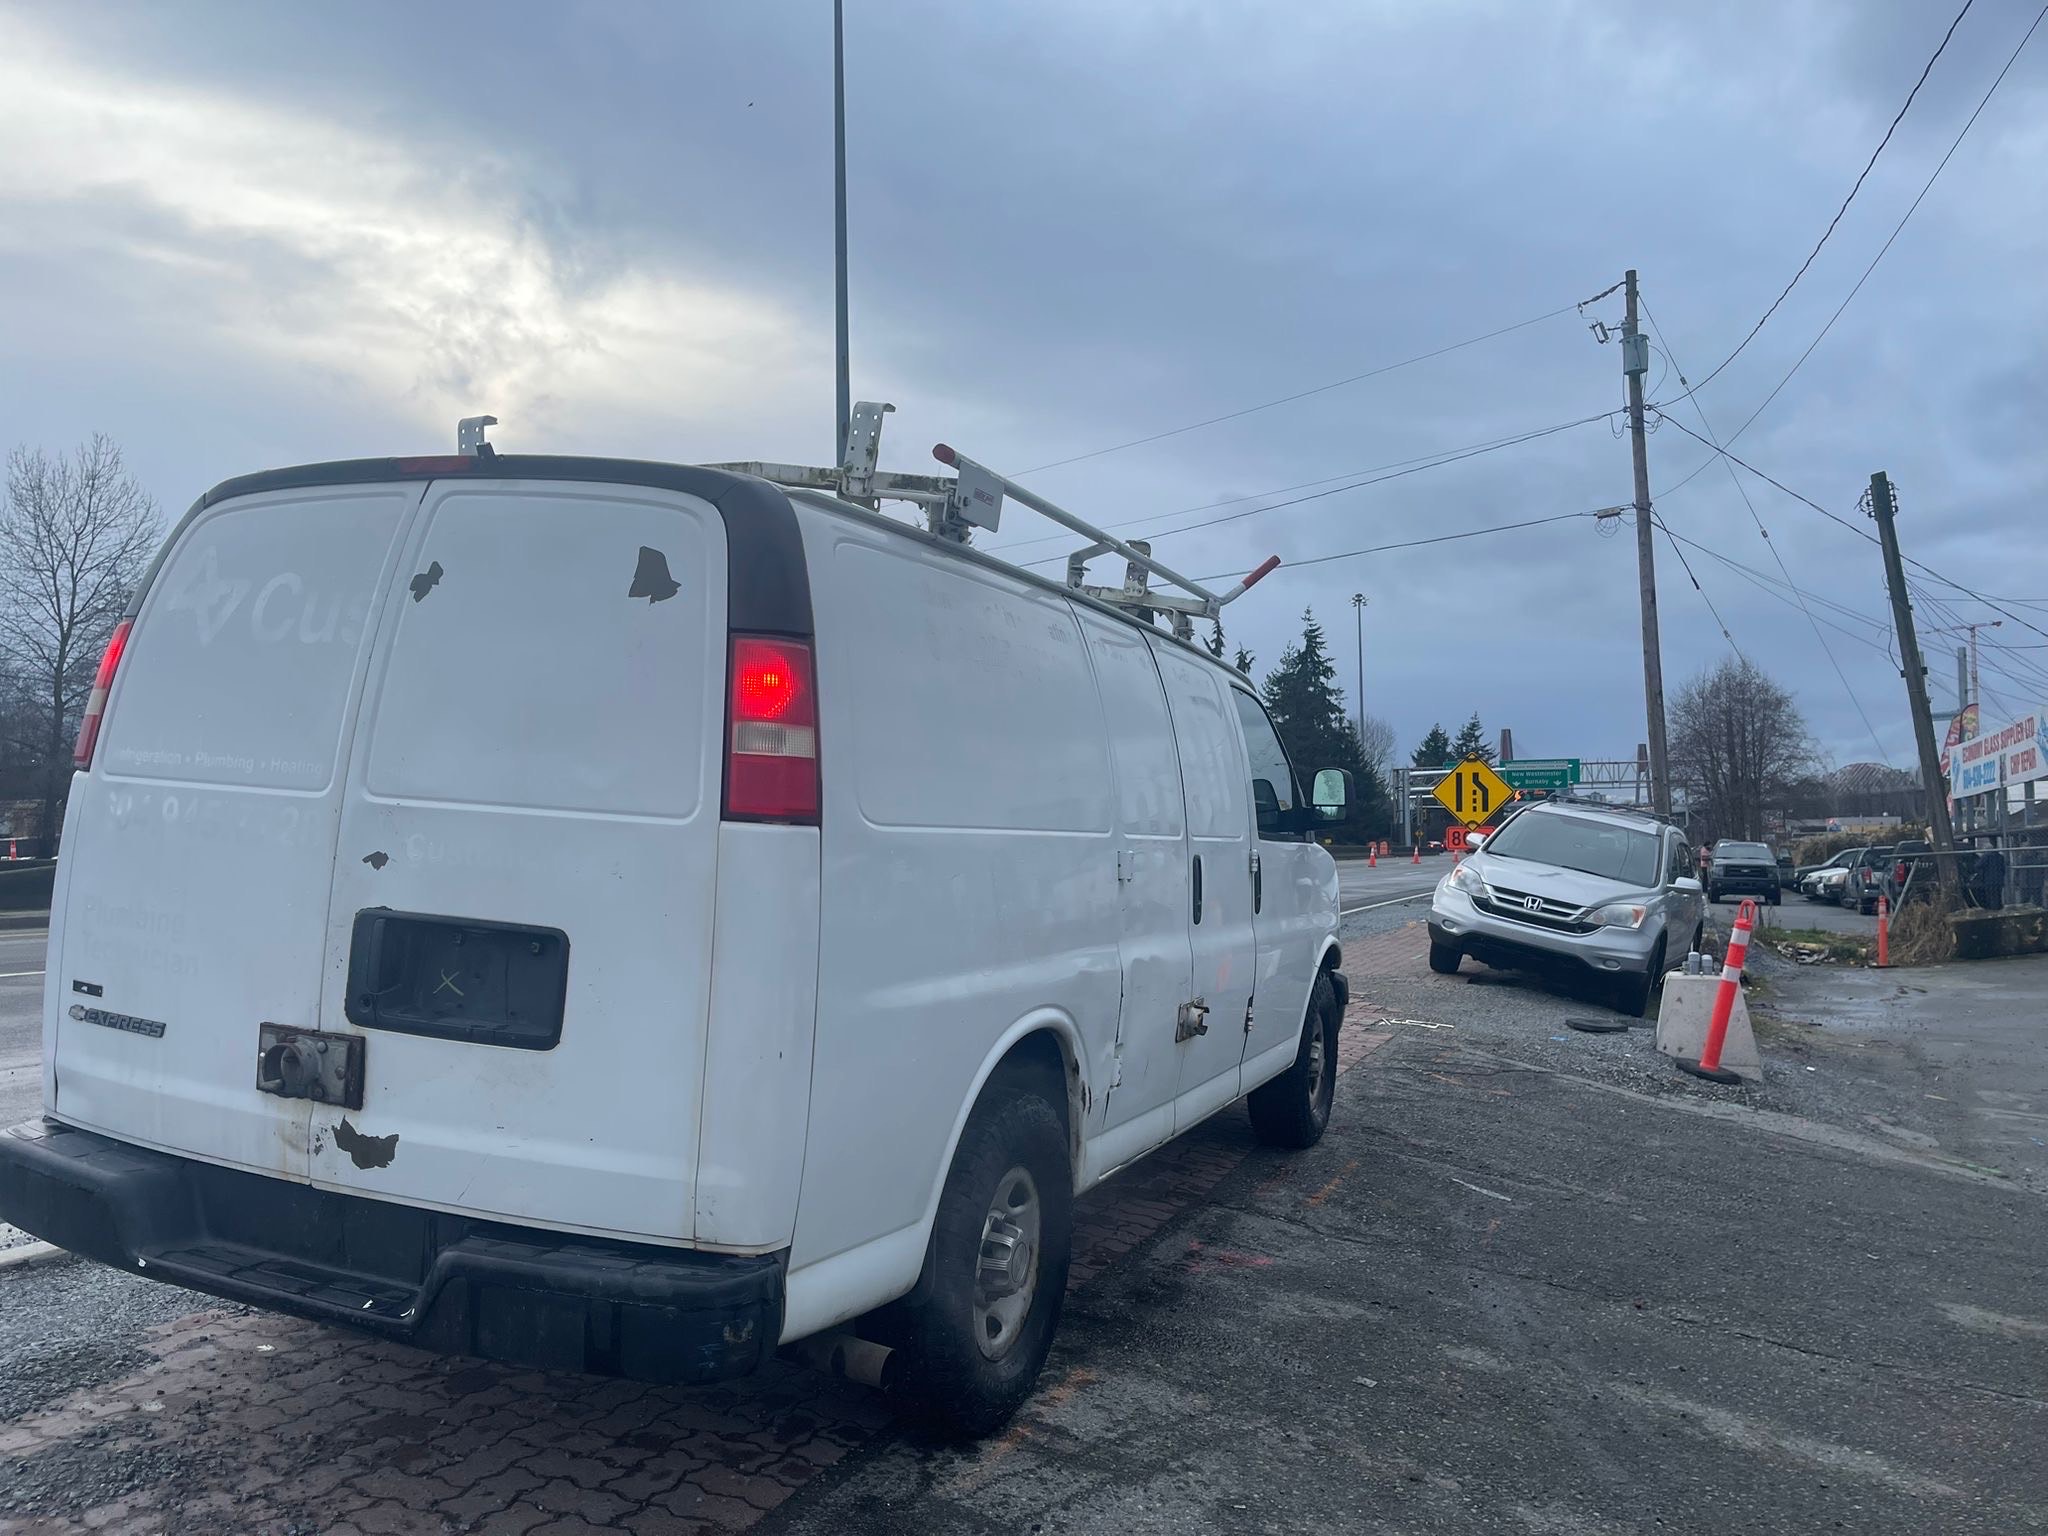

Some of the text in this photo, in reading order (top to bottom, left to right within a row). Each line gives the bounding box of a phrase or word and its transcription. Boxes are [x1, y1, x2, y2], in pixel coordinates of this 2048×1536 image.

[1984, 733, 2000, 757] GLASS
[195, 751, 255, 775] Plumbing
[269, 756, 323, 778] Heating
[84, 1008, 166, 1038] EXPRESS
